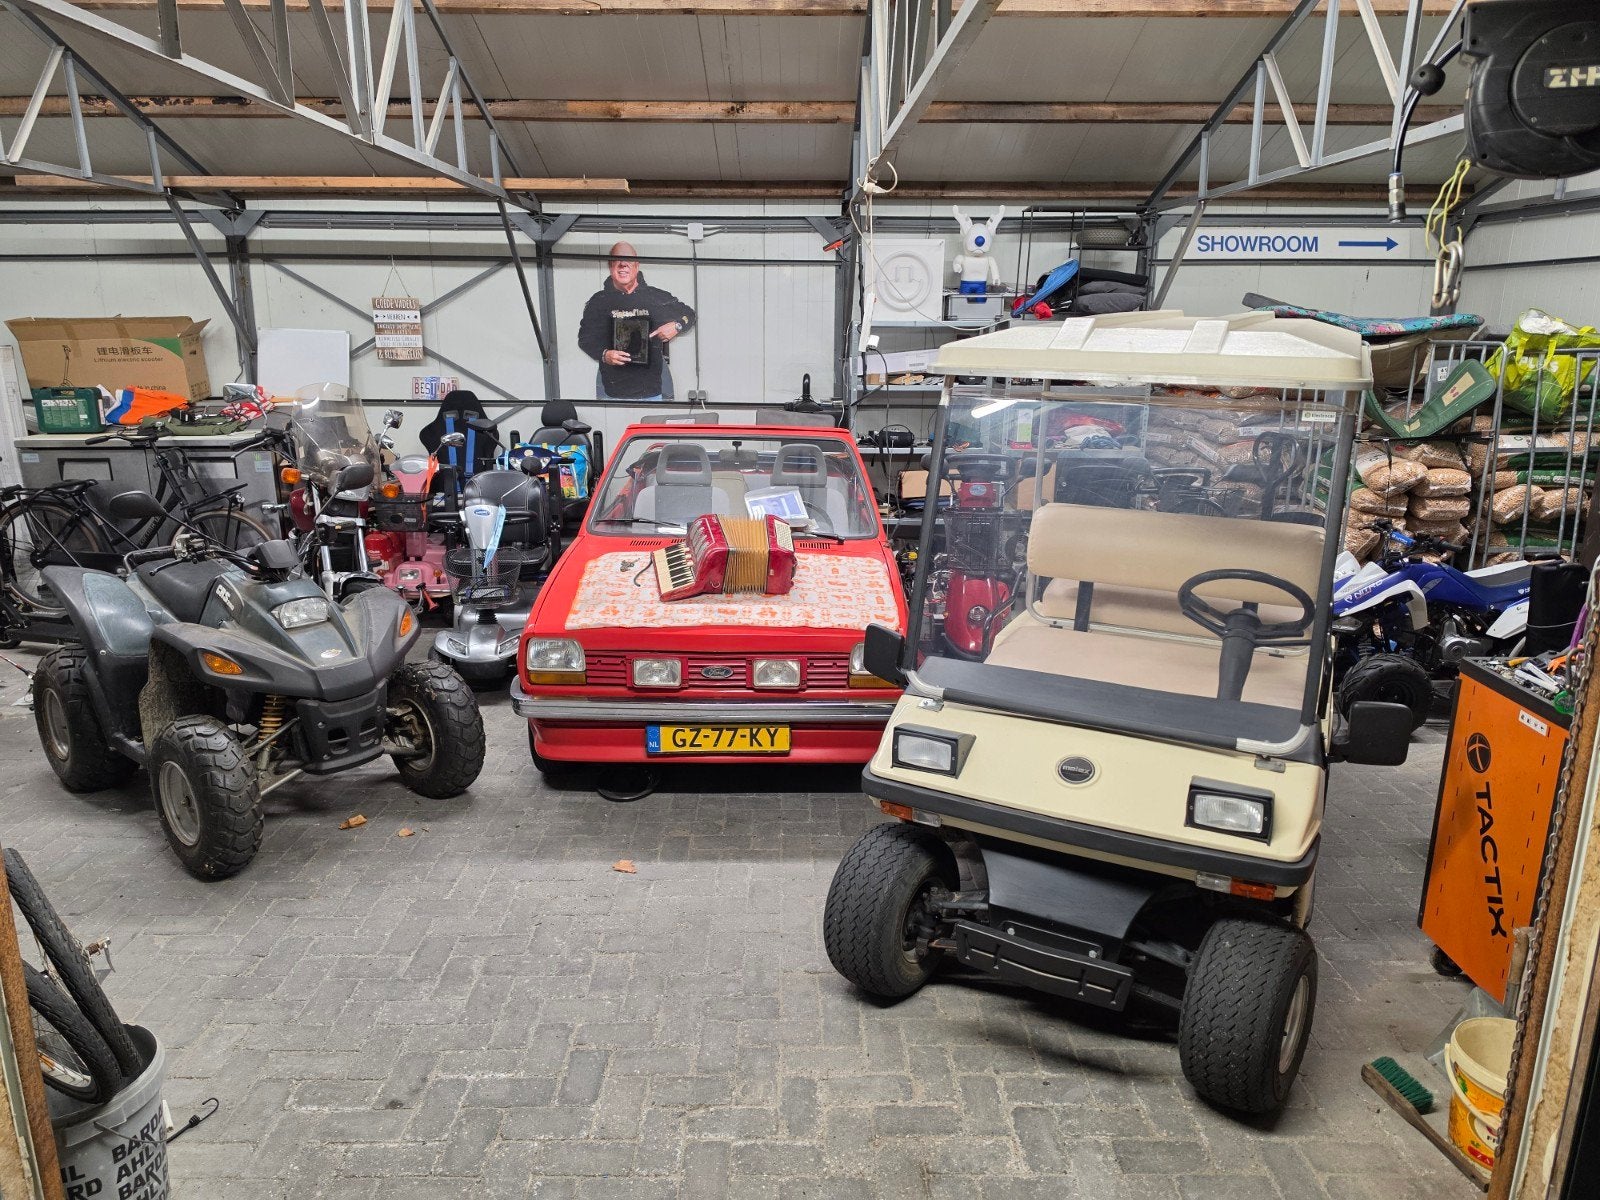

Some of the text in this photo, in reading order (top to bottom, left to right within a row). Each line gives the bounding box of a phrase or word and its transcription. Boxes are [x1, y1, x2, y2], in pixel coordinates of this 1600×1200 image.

[1197, 235, 1319, 252] SHOWROOM
[375, 298, 416, 309] GOEDE VADERS
[97, 346, 153, 356] 锂电滑板车
[415, 382, 458, 395] BEST DAD
[672, 727, 779, 748] GZ-77-KY
[1475, 781, 1508, 939] TACTIX
